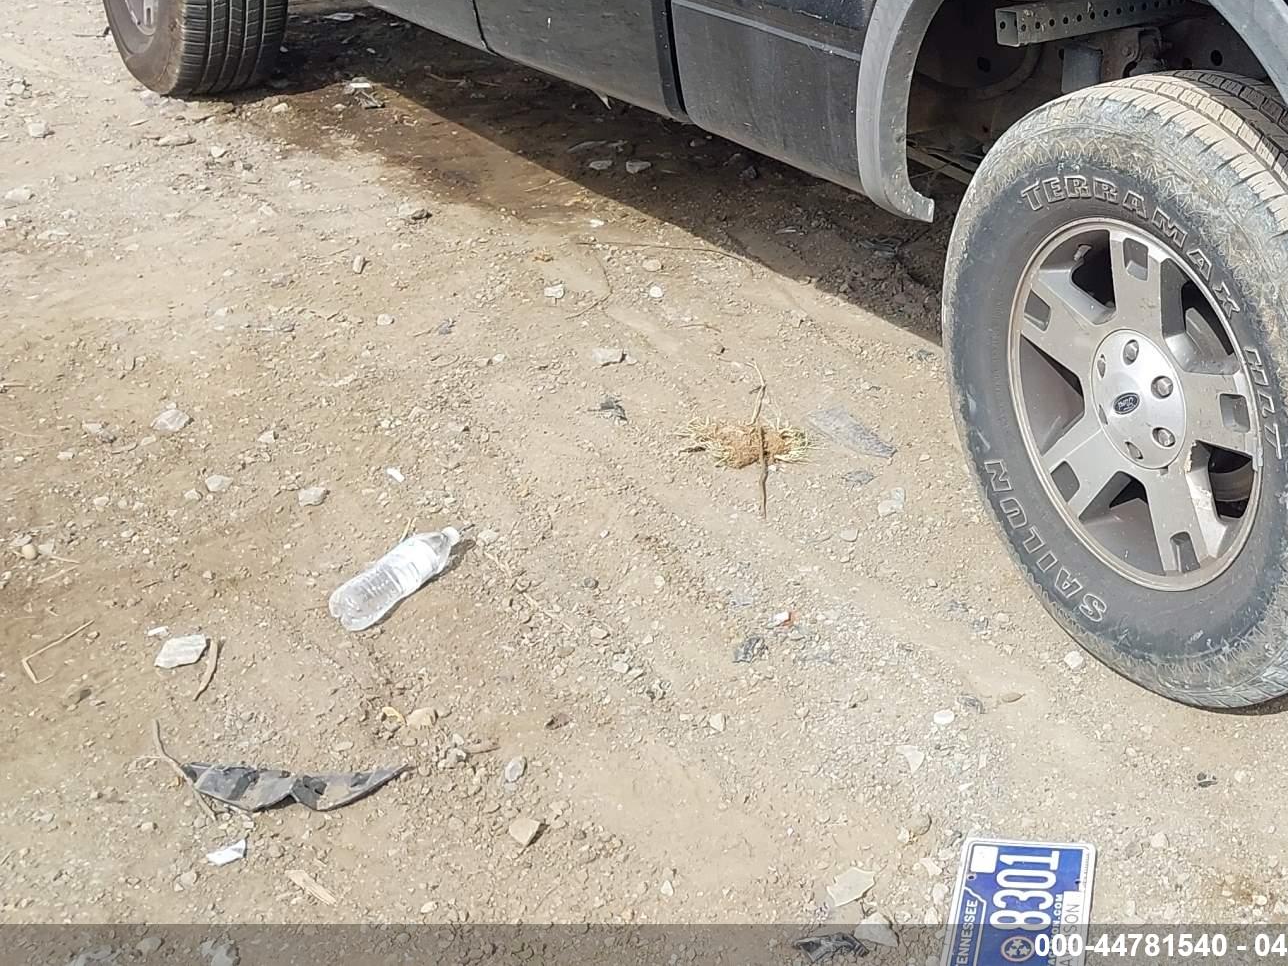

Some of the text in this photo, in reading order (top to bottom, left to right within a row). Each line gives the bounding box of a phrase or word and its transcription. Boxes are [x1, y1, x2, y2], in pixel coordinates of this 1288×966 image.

[1021, 175, 1241, 320] TERRAMAX
[985, 459, 1107, 623] SAILUN
[956, 899, 978, 966] ENNESSEE
